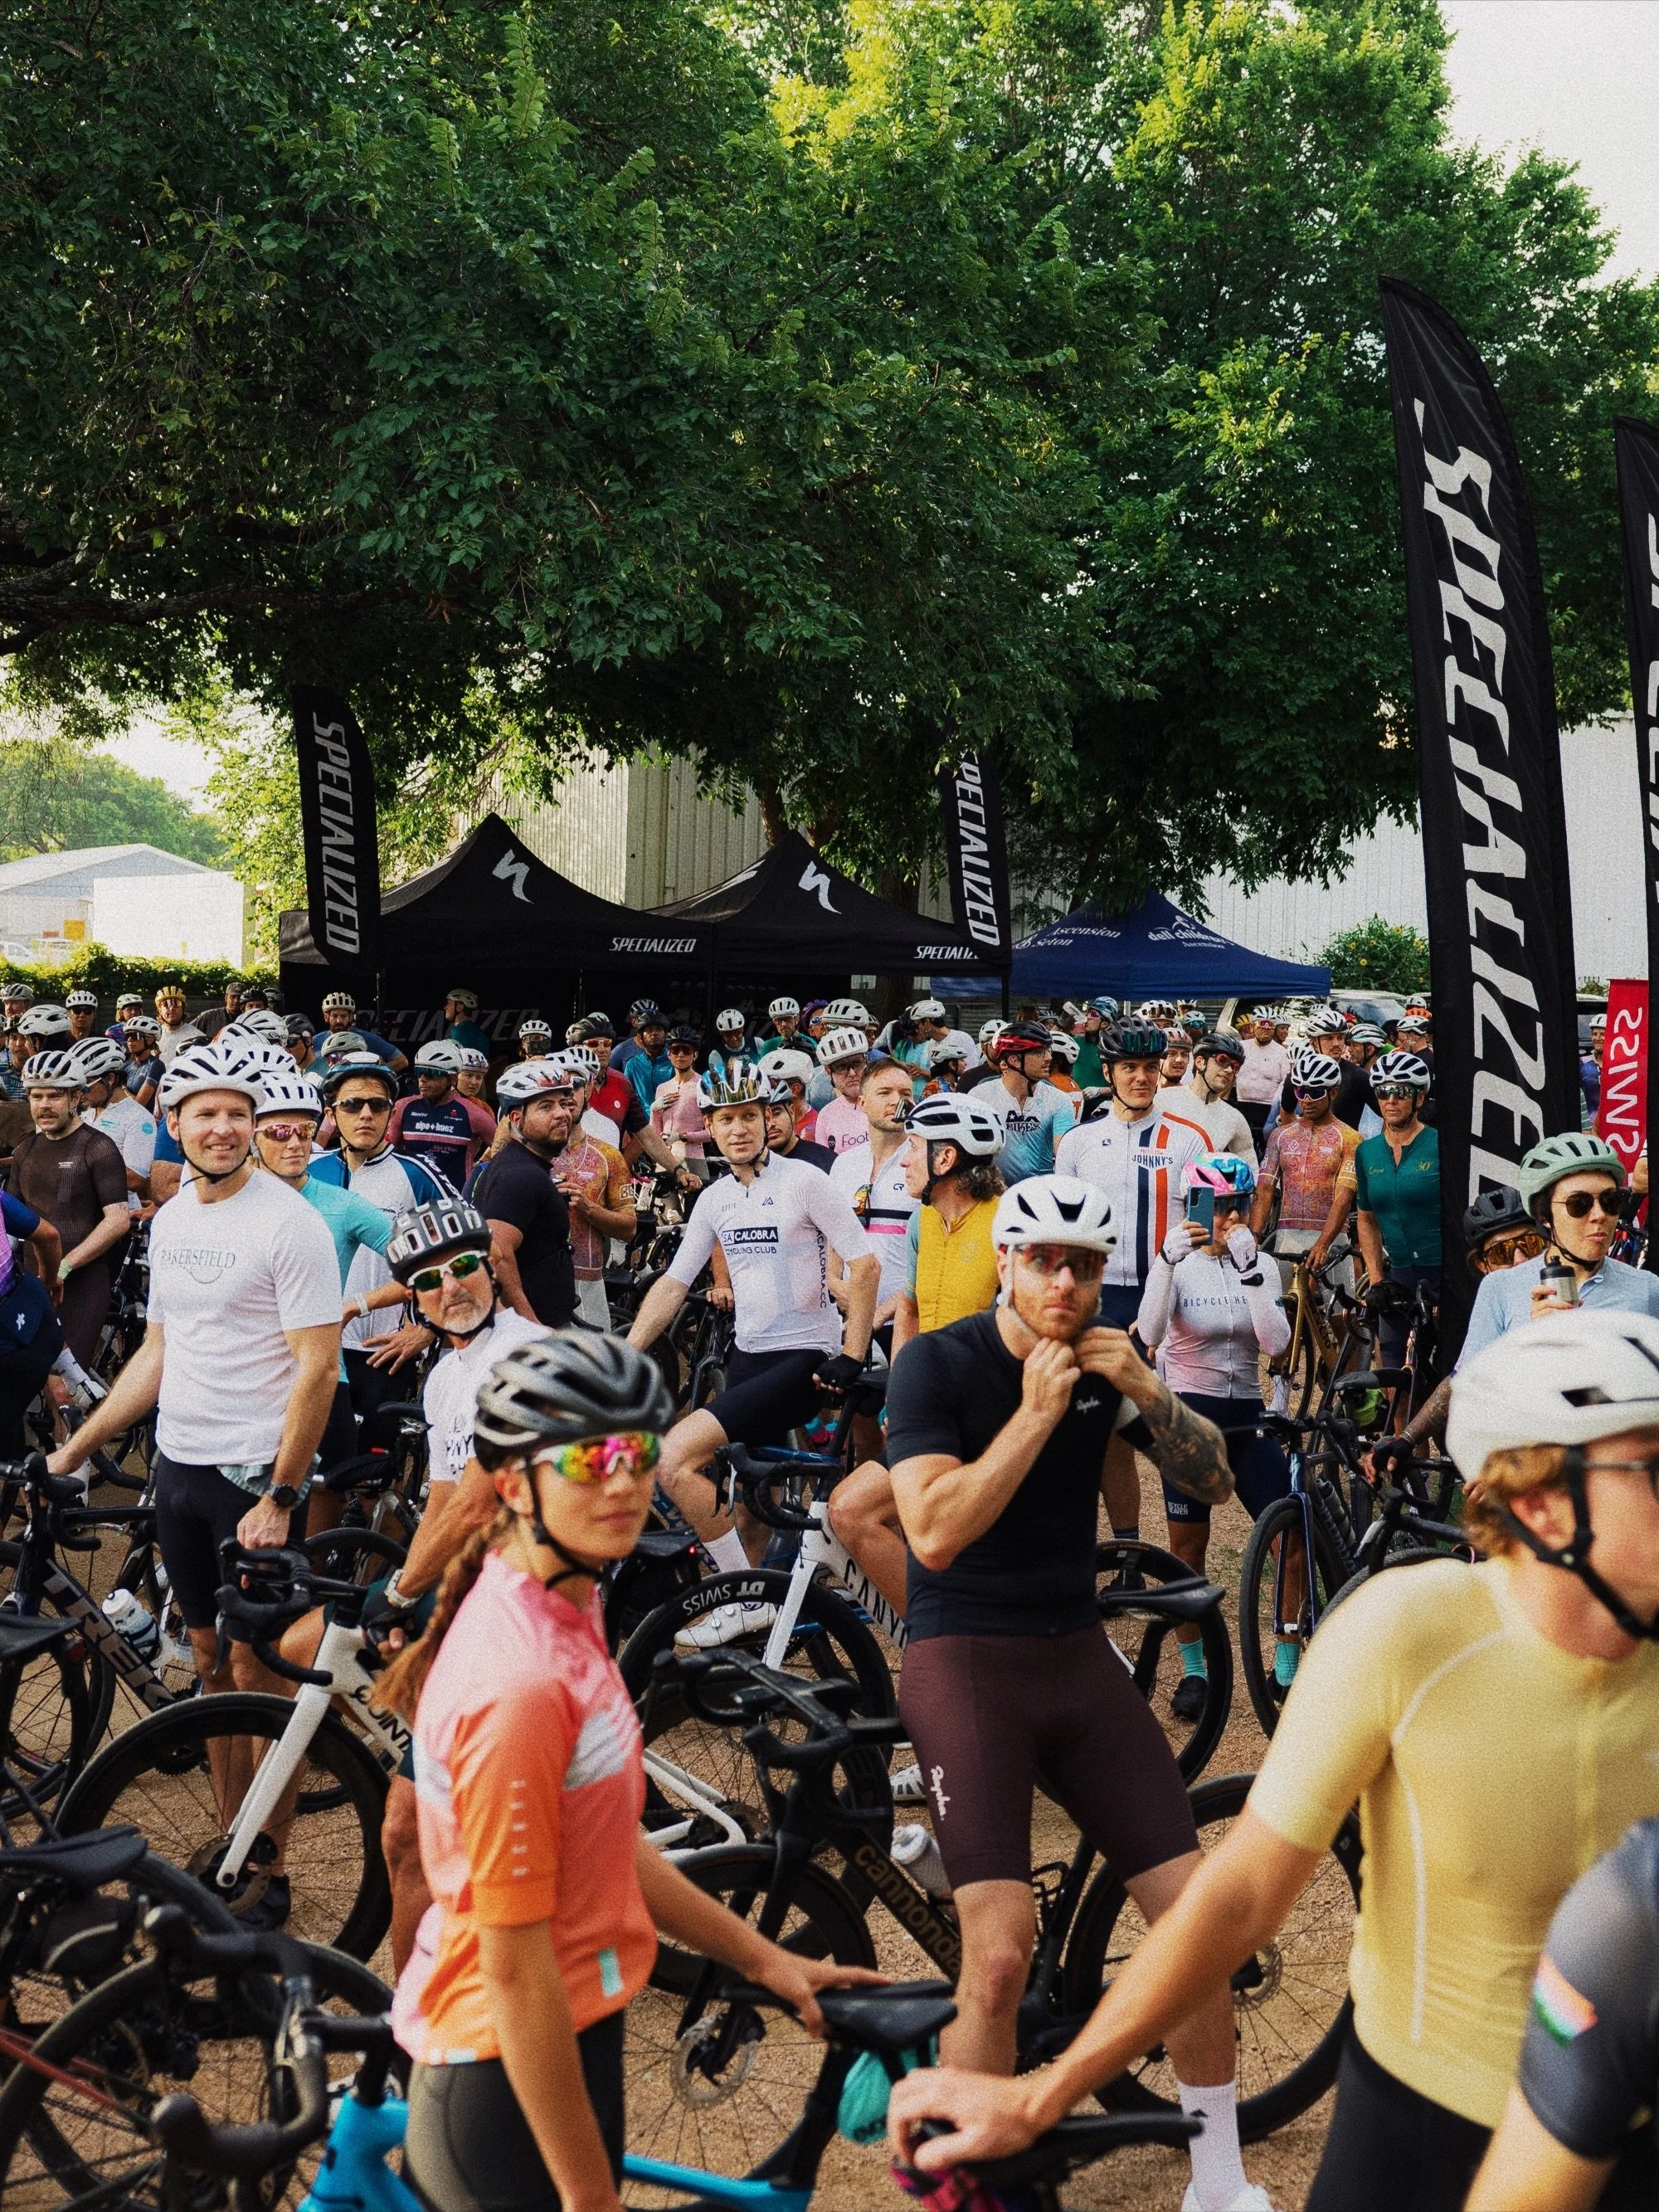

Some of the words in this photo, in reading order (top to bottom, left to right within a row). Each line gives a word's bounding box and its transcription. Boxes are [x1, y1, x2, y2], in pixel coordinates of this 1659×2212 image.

[312, 711, 360, 954] SPECIALIZED
[1045, 927, 1121, 938] Ascension
[1147, 929, 1175, 942] dell
[609, 937, 697, 953] SPECIALIZED
[1131, 1154, 1174, 1168] JOHNNY'S
[734, 1229, 777, 1241] CALOBRA
[725, 1246, 753, 1255] CYCLING
[754, 1245, 777, 1254] CLUB
[161, 1248, 236, 1269] BAKERSFIELD
[816, 1228, 828, 1308] ACALOBRA.CC
[1184, 1295, 1229, 1308] BICYCLE
[736, 1581, 766, 1596] DT
[683, 1583, 731, 1615] SWISS
[844, 1557, 907, 1649] CANY
